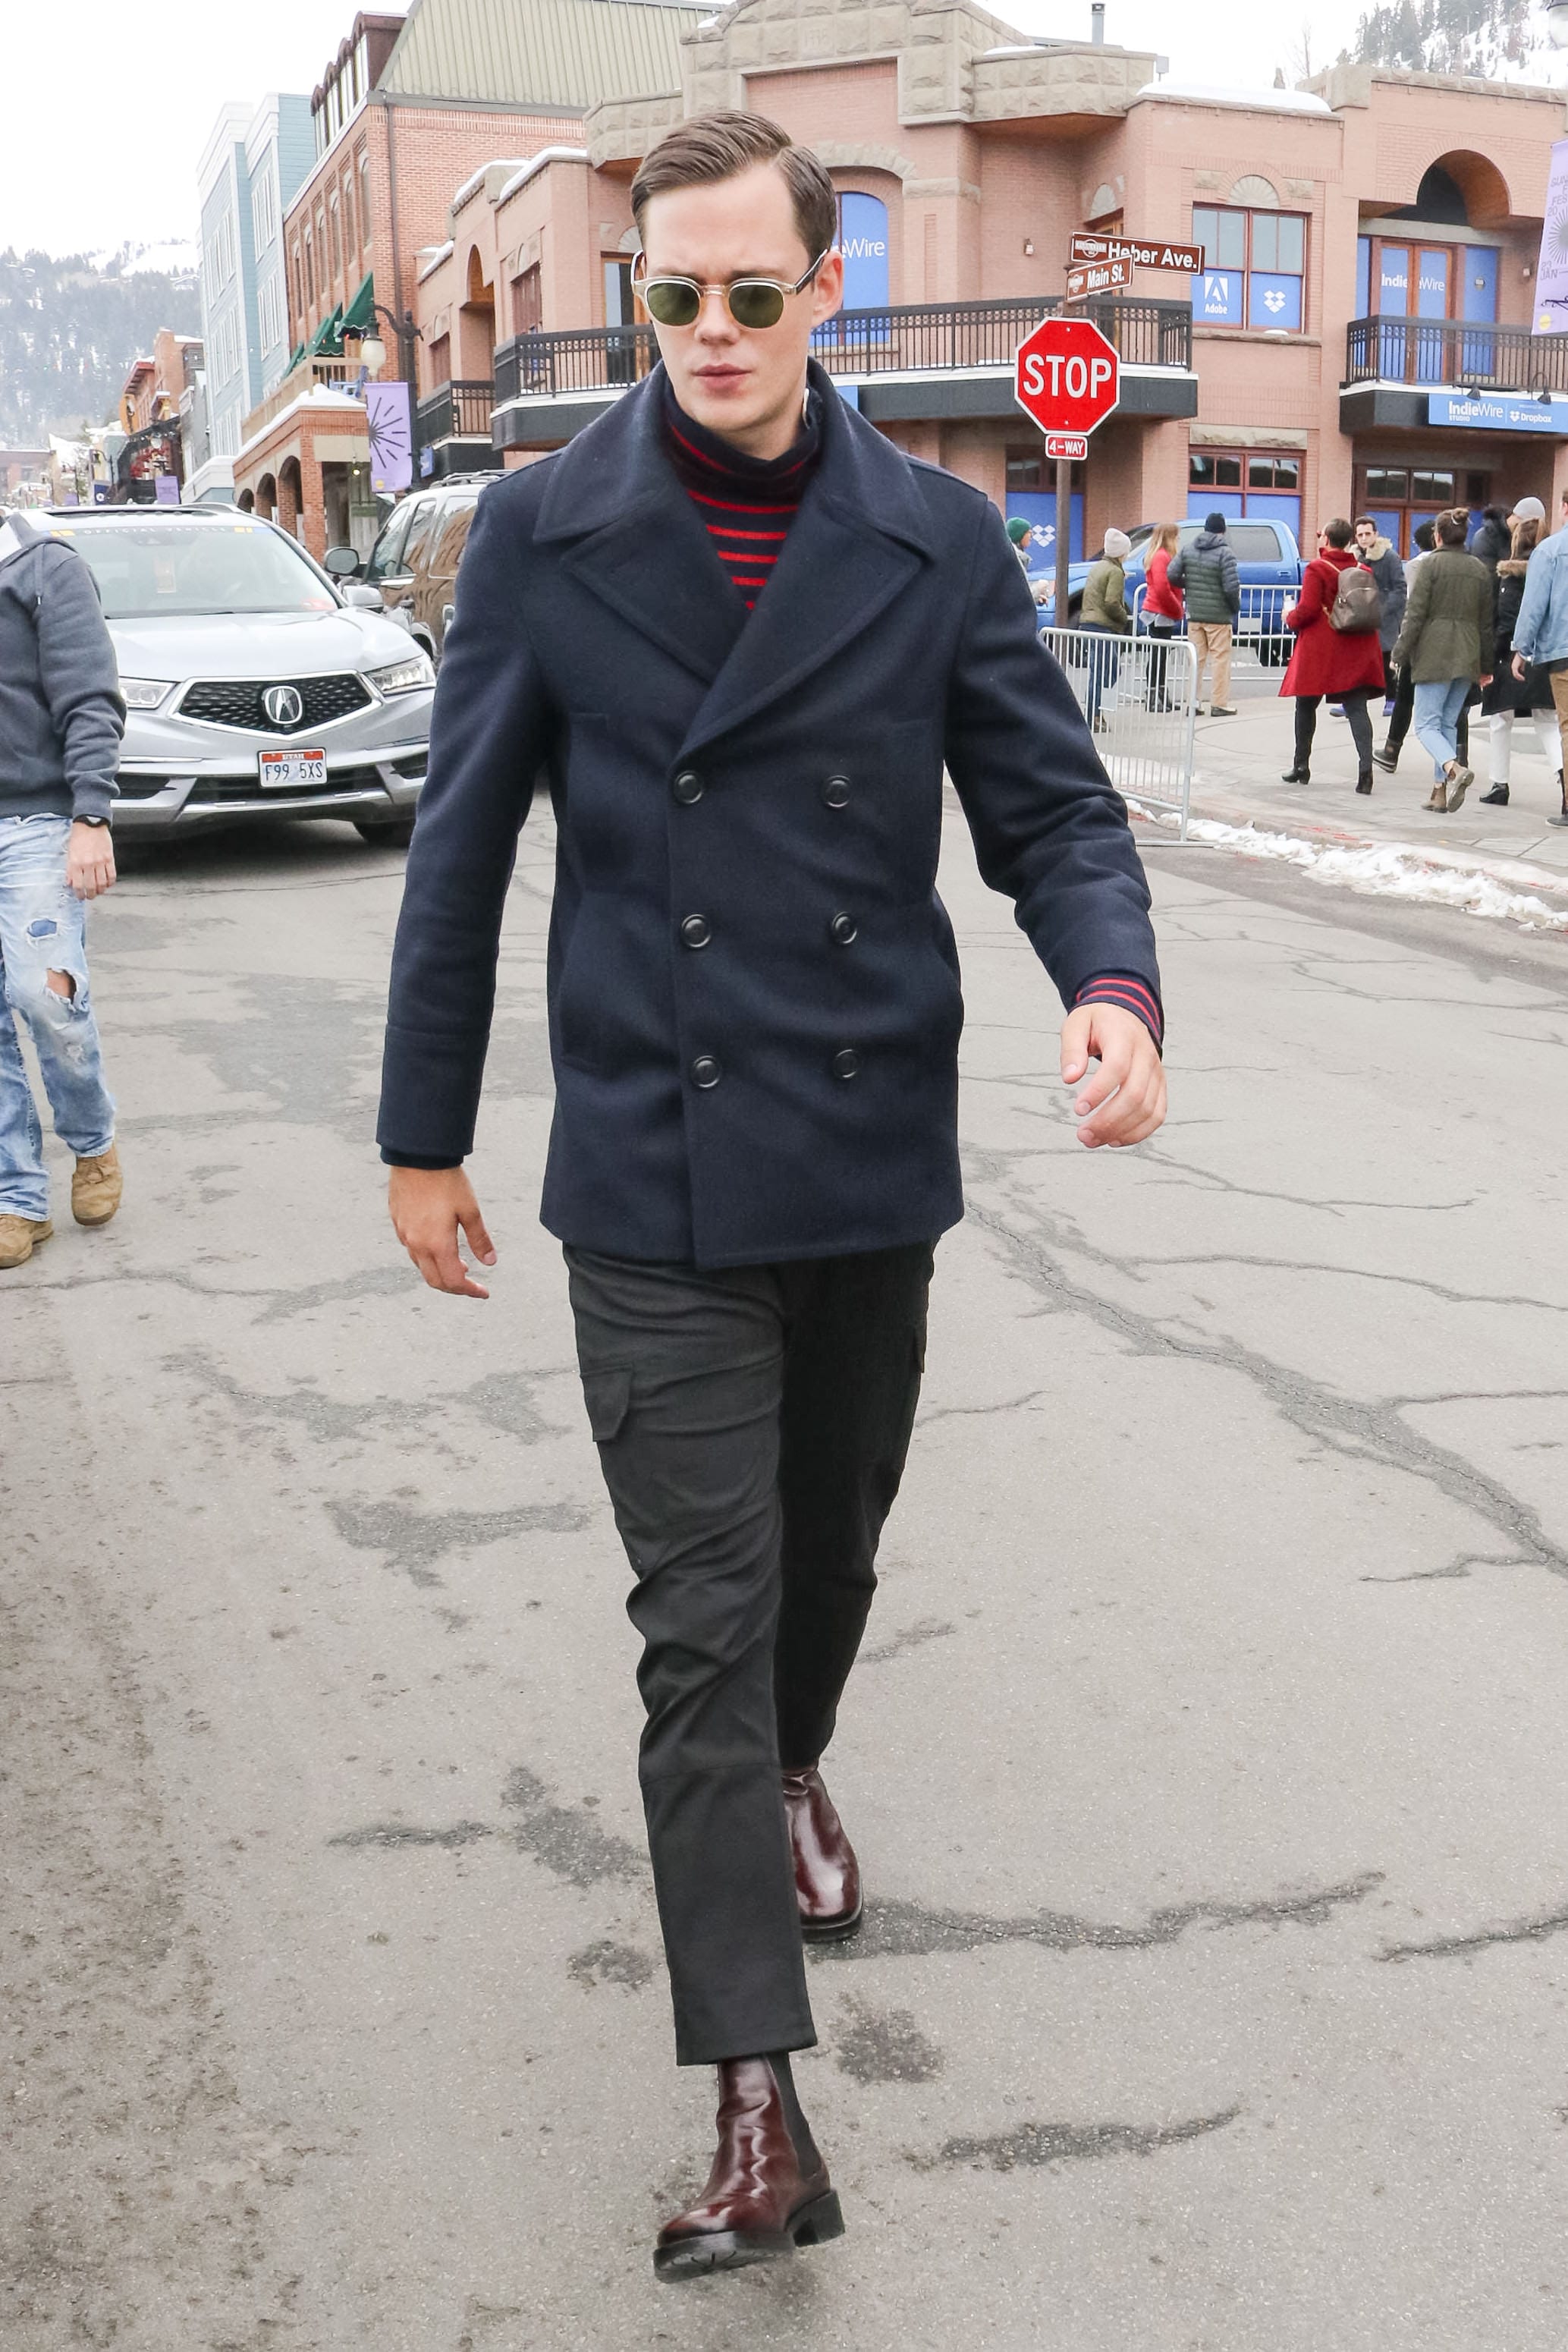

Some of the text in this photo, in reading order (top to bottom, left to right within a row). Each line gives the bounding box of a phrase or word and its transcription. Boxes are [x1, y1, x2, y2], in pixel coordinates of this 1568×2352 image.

[1108, 241, 1158, 264] Heber
[1161, 248, 1197, 269] Ave.
[1087, 269, 1109, 289] Main
[1111, 264, 1124, 283] St.
[1205, 303, 1228, 315] Adobe
[1023, 354, 1112, 399] STOP
[1448, 401, 1504, 418] IndieWire
[1520, 412, 1552, 424] Dropbox
[1049, 439, 1083, 455] 4-WAY
[266, 763, 322, 781] F99 5XS
